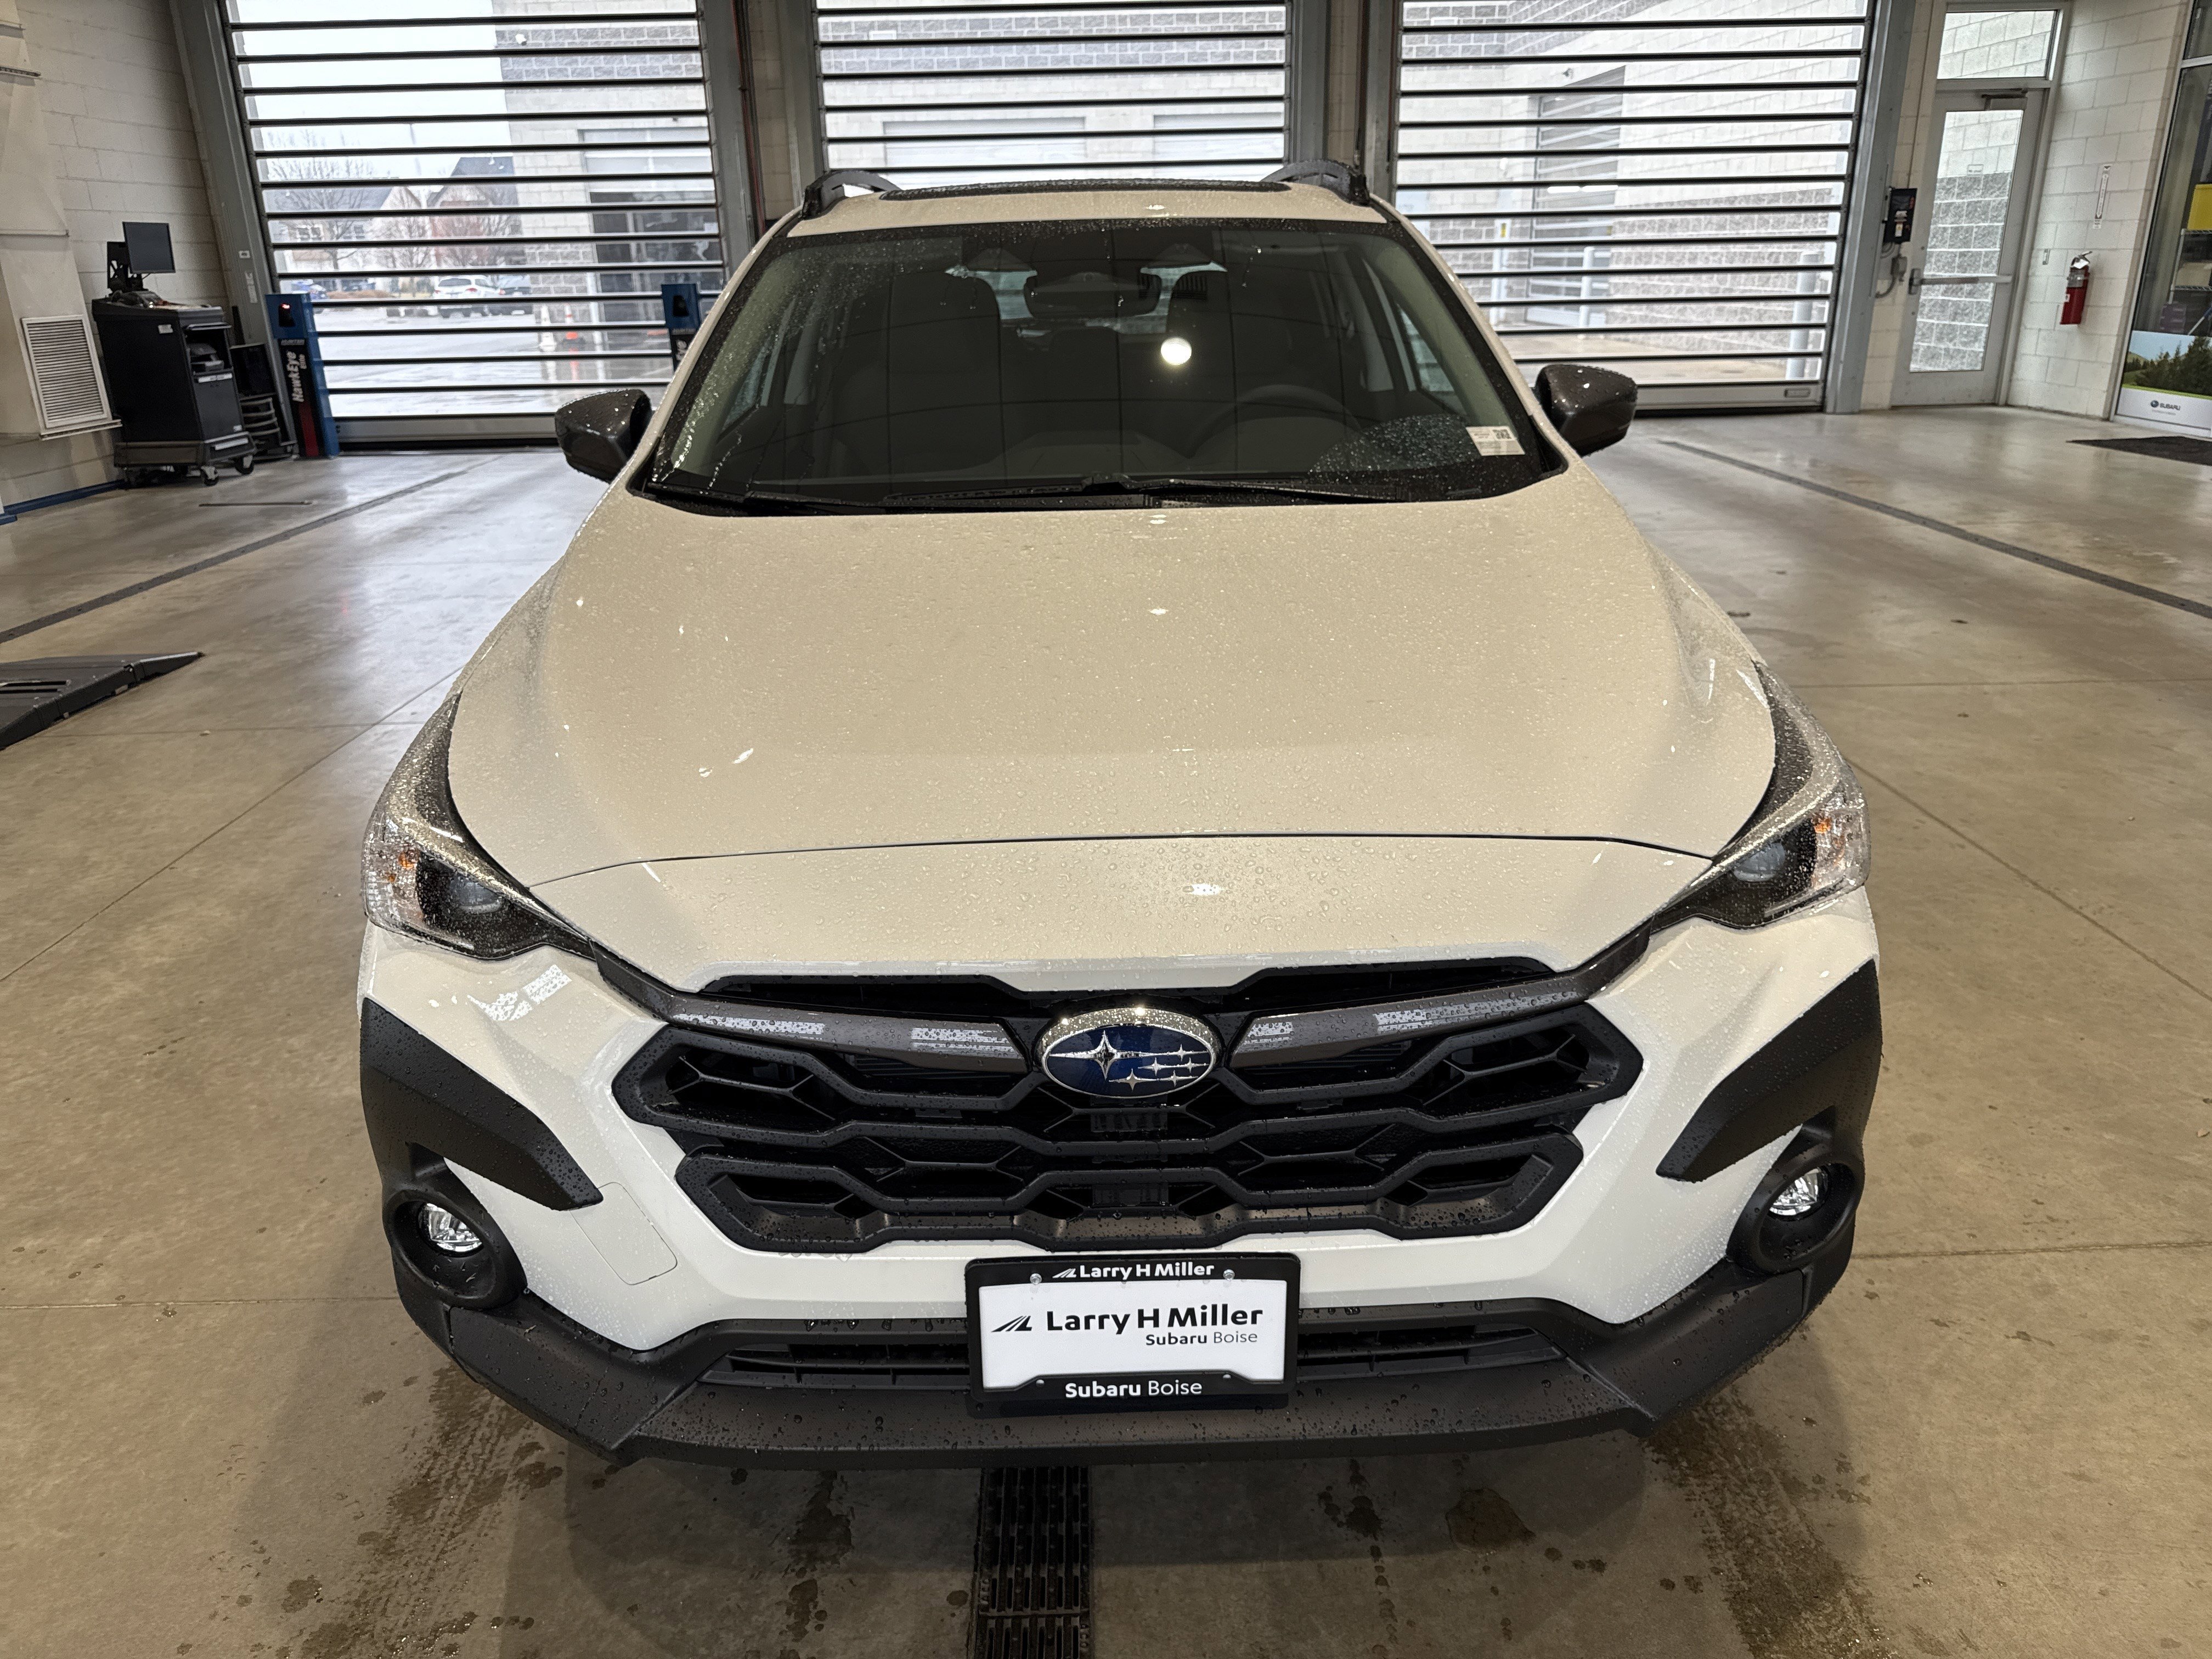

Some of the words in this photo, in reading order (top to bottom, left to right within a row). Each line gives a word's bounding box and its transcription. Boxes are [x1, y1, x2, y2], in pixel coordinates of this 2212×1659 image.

[286, 351, 304, 402] HawkEye
[1080, 1265, 1133, 1280] Larry
[1136, 1263, 1150, 1277] H
[1154, 1261, 1215, 1277] Miller
[1047, 1311, 1131, 1335] Larry
[1137, 1308, 1160, 1329] H
[1167, 1304, 1263, 1328] Miller
[1146, 1332, 1207, 1346] Subaru
[1214, 1331, 1258, 1344] Boise
[1065, 1380, 1141, 1398] Subaru
[1148, 1380, 1203, 1396] Boise
